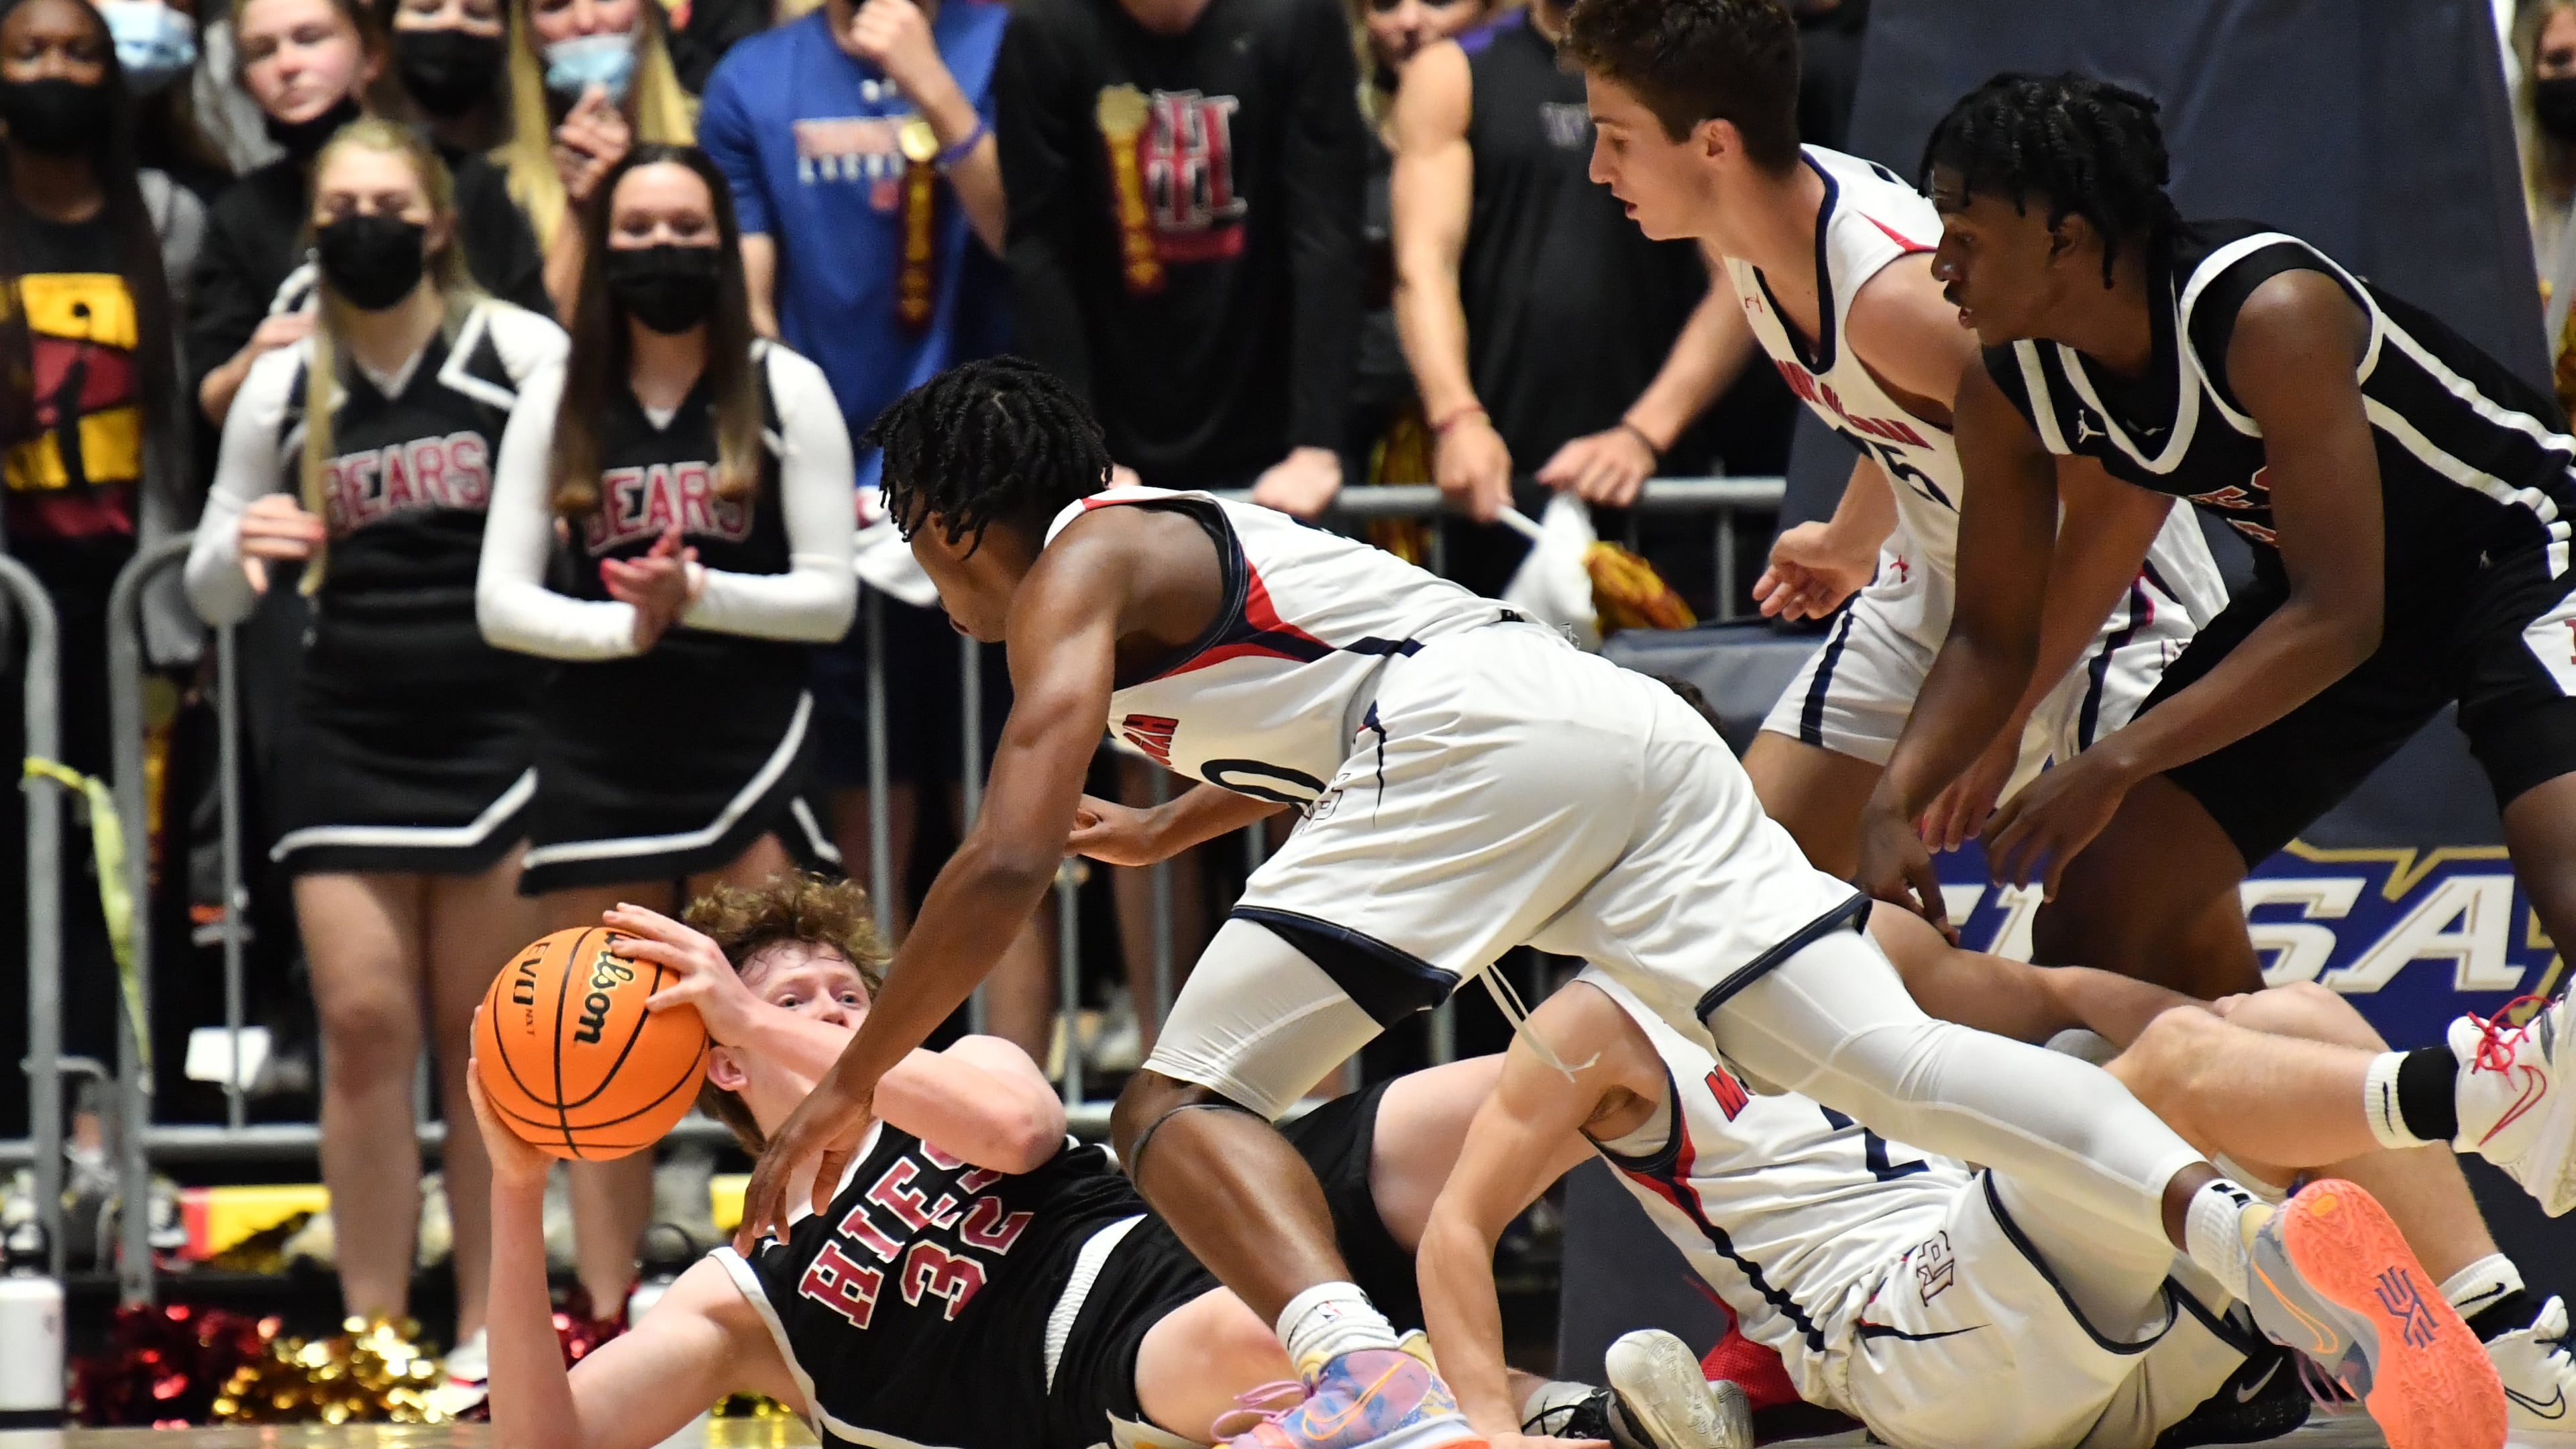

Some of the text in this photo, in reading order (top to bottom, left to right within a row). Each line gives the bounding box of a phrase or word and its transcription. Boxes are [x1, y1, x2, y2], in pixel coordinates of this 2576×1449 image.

[322, 430, 493, 539] BEARS
[513, 941, 551, 1006] EVO
[574, 931, 636, 1044] ilson
[899, 1195, 1036, 1322] 32
